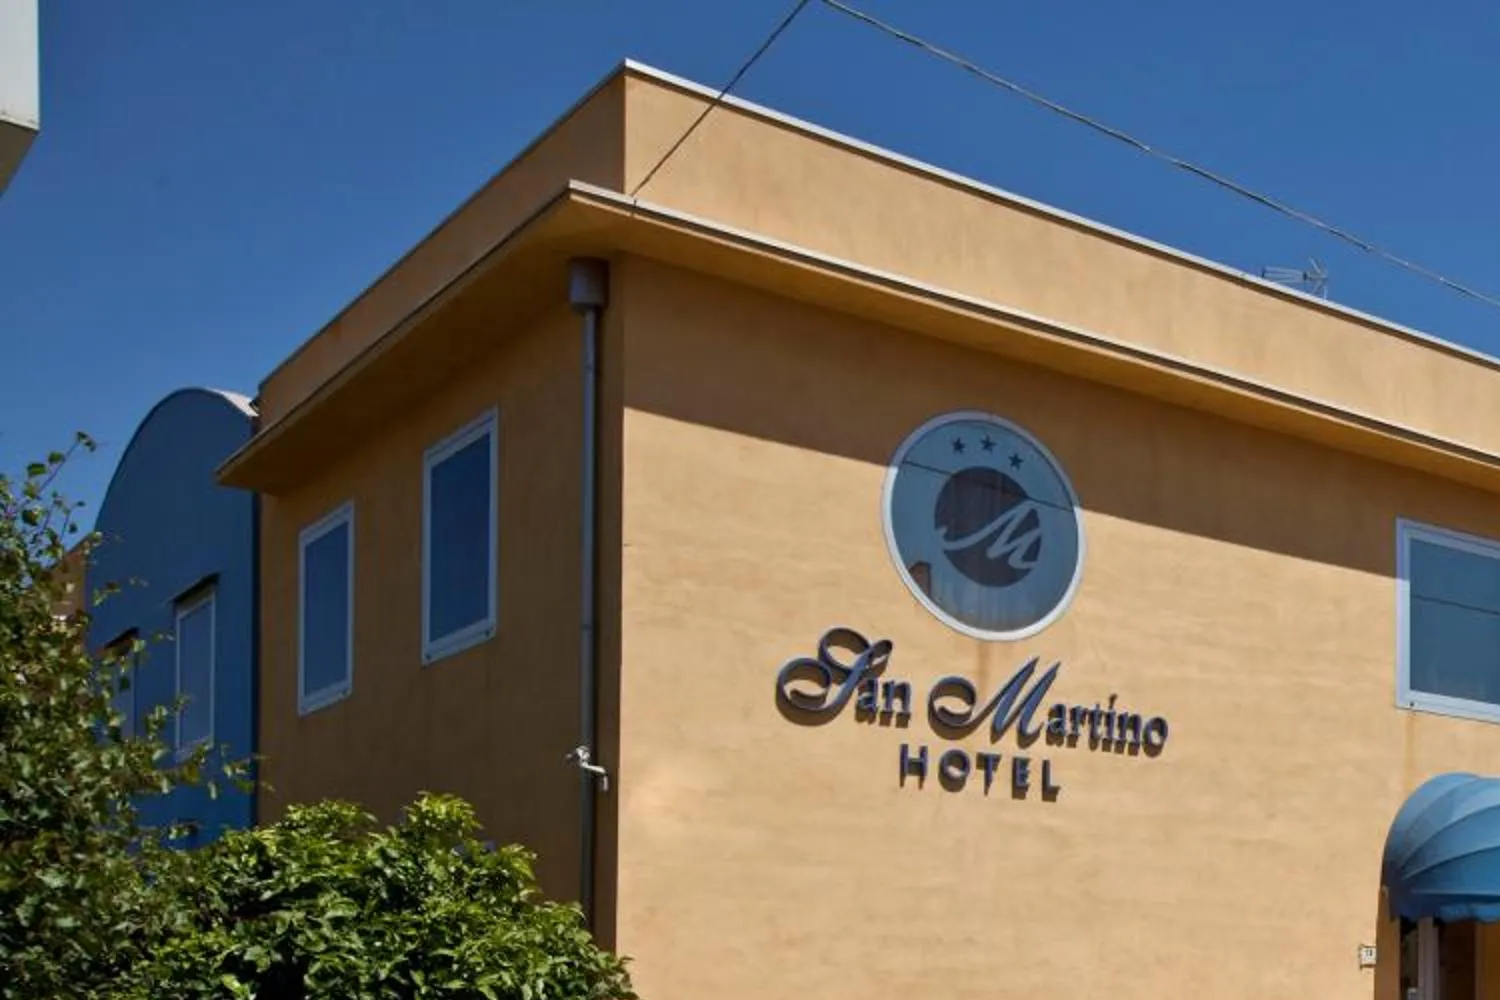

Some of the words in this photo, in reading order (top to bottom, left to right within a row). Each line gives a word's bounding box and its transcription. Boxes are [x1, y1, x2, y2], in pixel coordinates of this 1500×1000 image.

[775, 627, 912, 727] San
[928, 656, 1169, 757] Martino
[899, 743, 1061, 802] HOTEL
